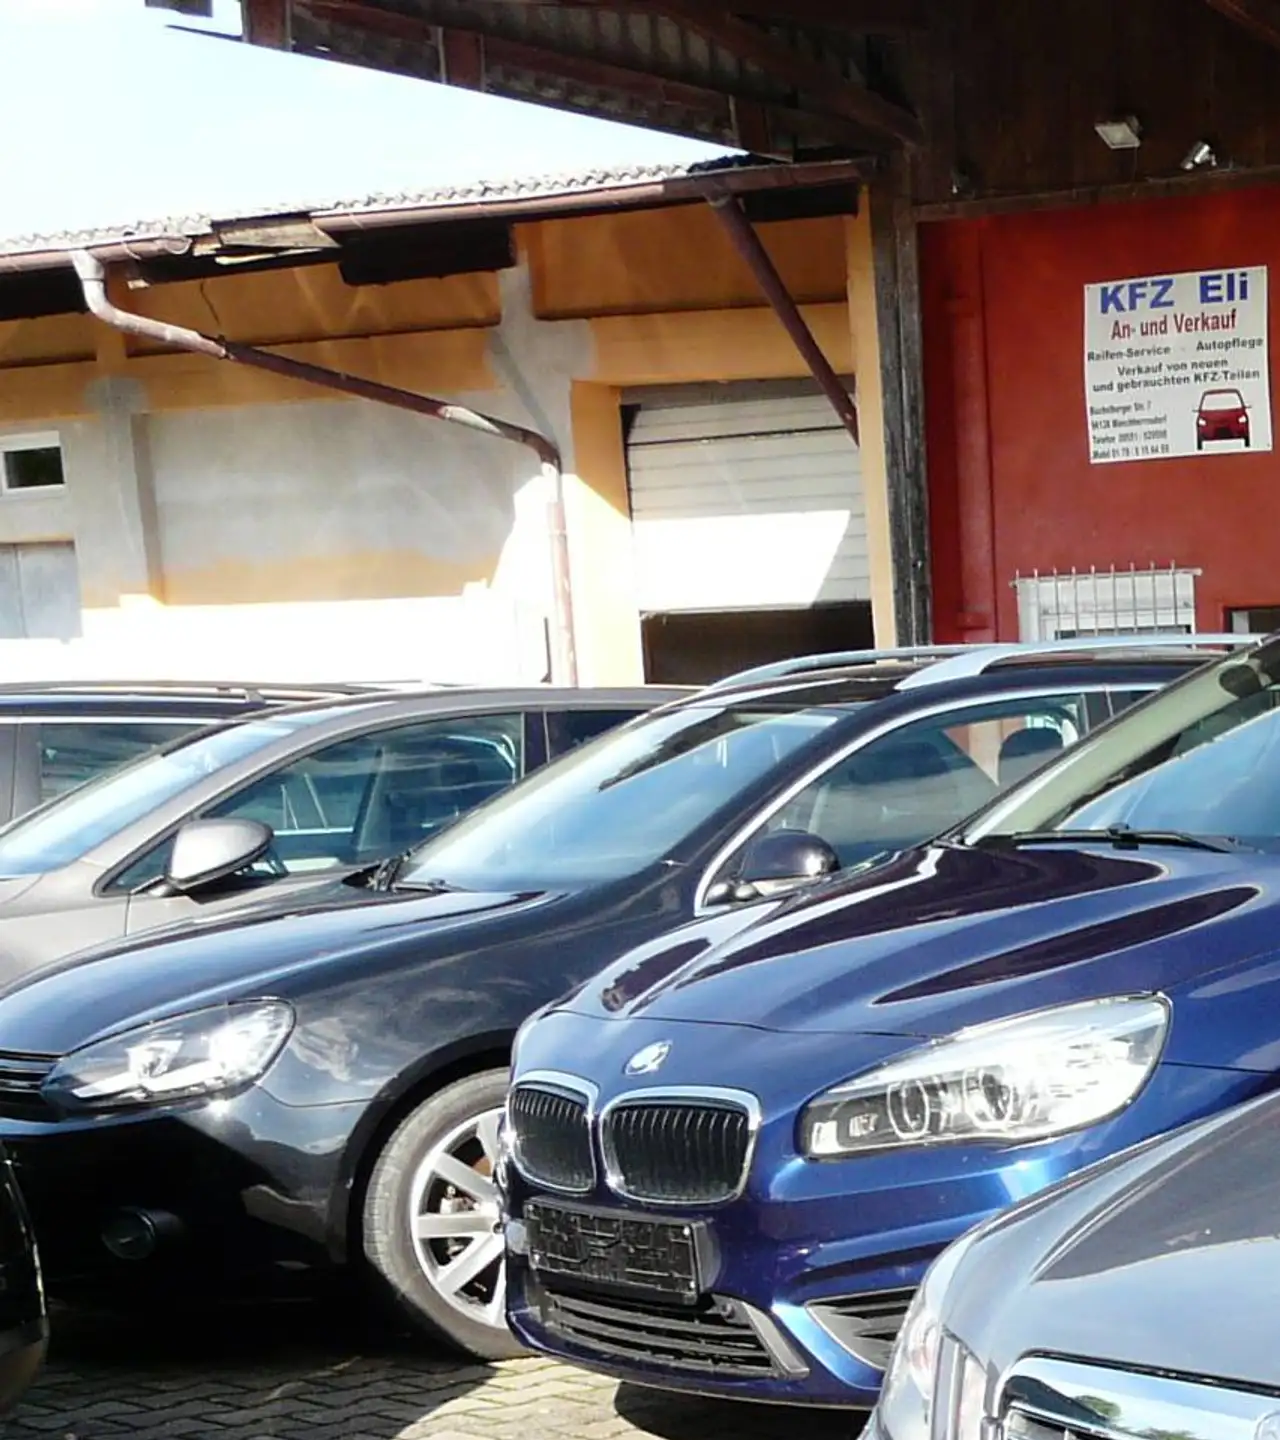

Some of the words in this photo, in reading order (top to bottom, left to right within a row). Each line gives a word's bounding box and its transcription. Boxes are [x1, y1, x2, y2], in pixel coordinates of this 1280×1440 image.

[1100, 278, 1174, 314] KFZ
[1200, 272, 1248, 304] Eli
[1111, 320, 1136, 340] An-
[1141, 315, 1168, 336] und
[1173, 309, 1237, 333] Verkauf
[1087, 345, 1171, 361] Reifen-Service
[1196, 337, 1263, 352] Autopflege
[1117, 362, 1163, 376] Verkauf
[1167, 362, 1188, 371] von
[1191, 358, 1228, 370] neuen
[1093, 381, 1114, 392] und
[1117, 374, 1190, 393] gebrauchten
[1194, 370, 1260, 384] KFZ-Teilen
